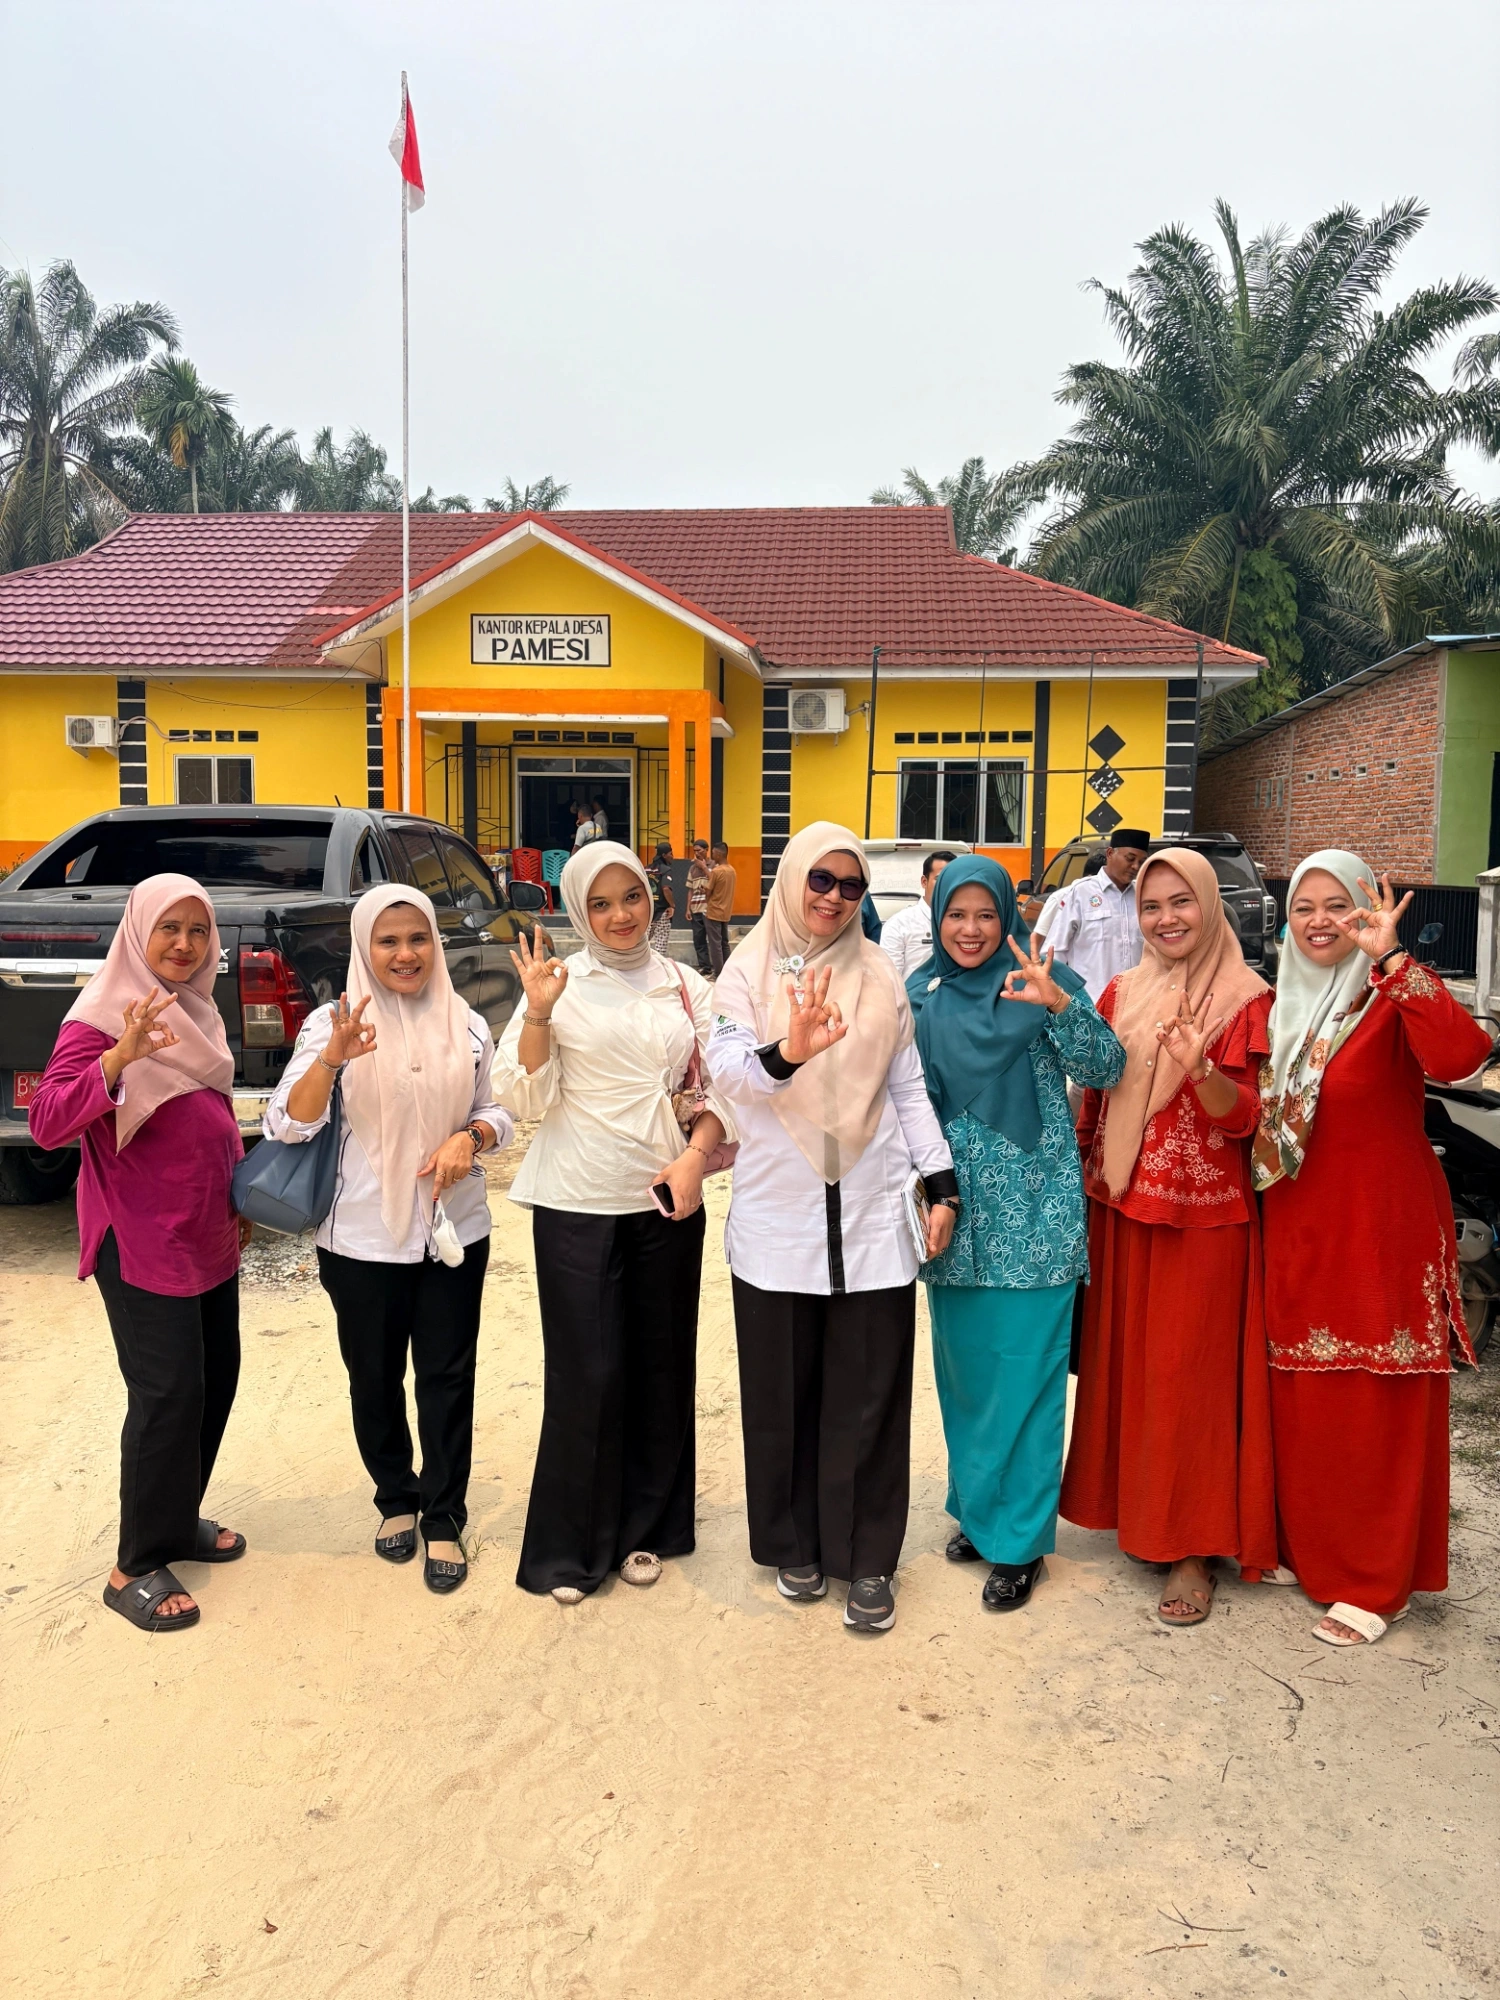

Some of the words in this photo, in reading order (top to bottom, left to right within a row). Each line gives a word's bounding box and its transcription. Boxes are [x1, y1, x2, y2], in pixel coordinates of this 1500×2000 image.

[478, 620, 523, 634] KANTOR
[525, 620, 570, 634] KEPALA
[573, 620, 603, 634] DESA
[491, 638, 590, 661] PAMESI
